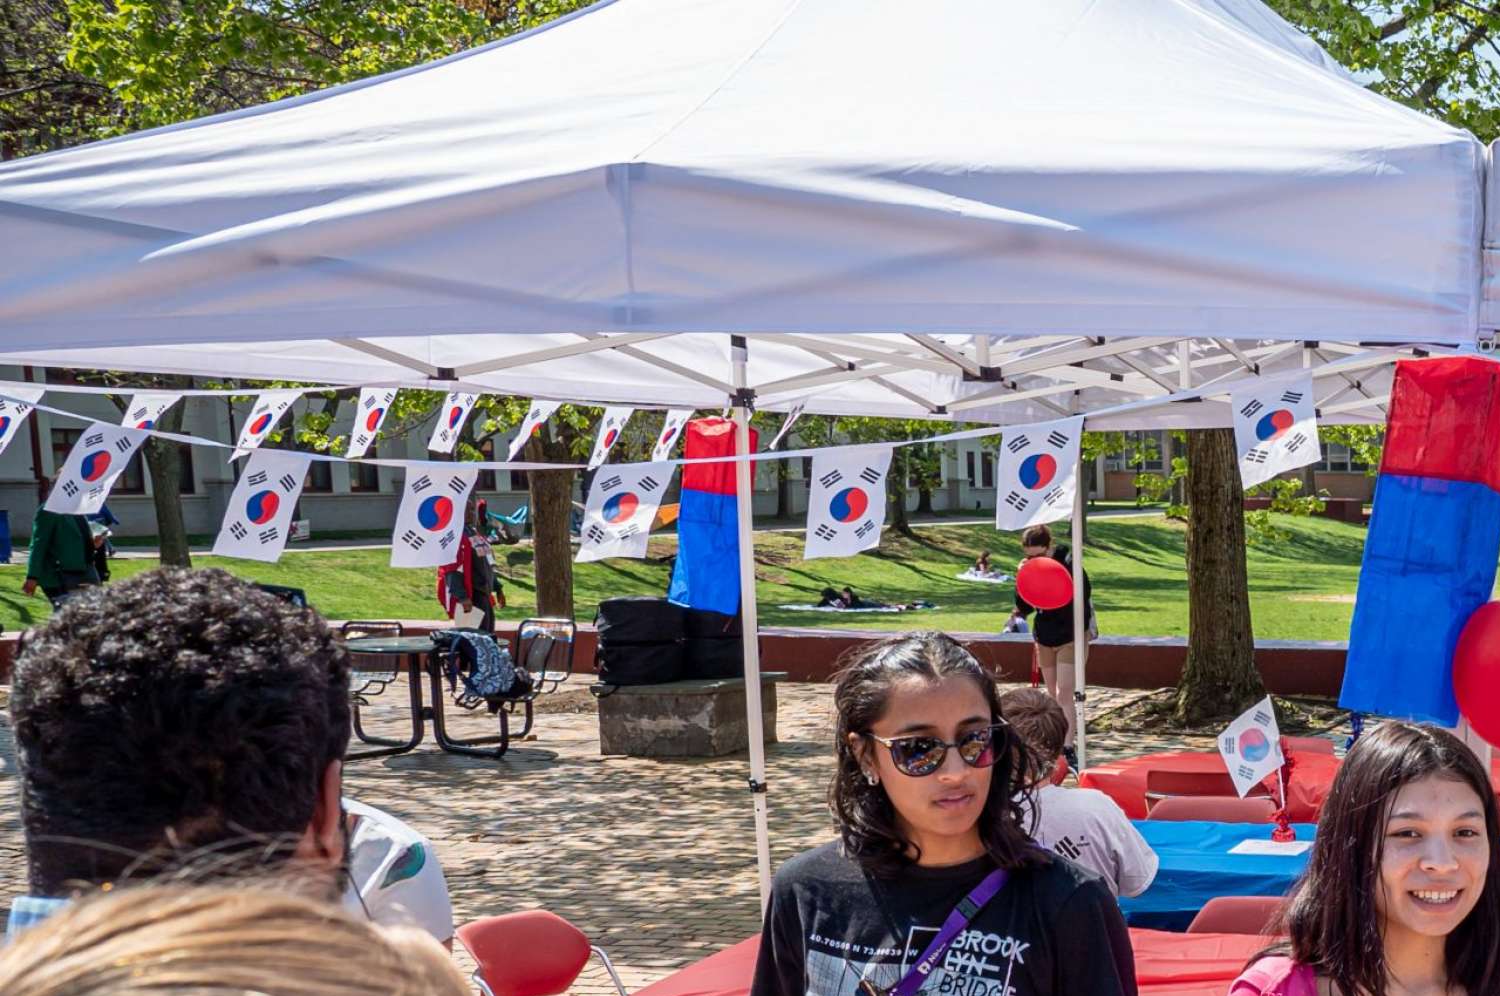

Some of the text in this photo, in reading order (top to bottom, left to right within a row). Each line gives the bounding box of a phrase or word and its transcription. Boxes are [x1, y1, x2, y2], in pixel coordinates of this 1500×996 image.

[852, 944, 861, 952] N
[951, 930, 1029, 964] BROOK
[944, 950, 989, 976] LYN
